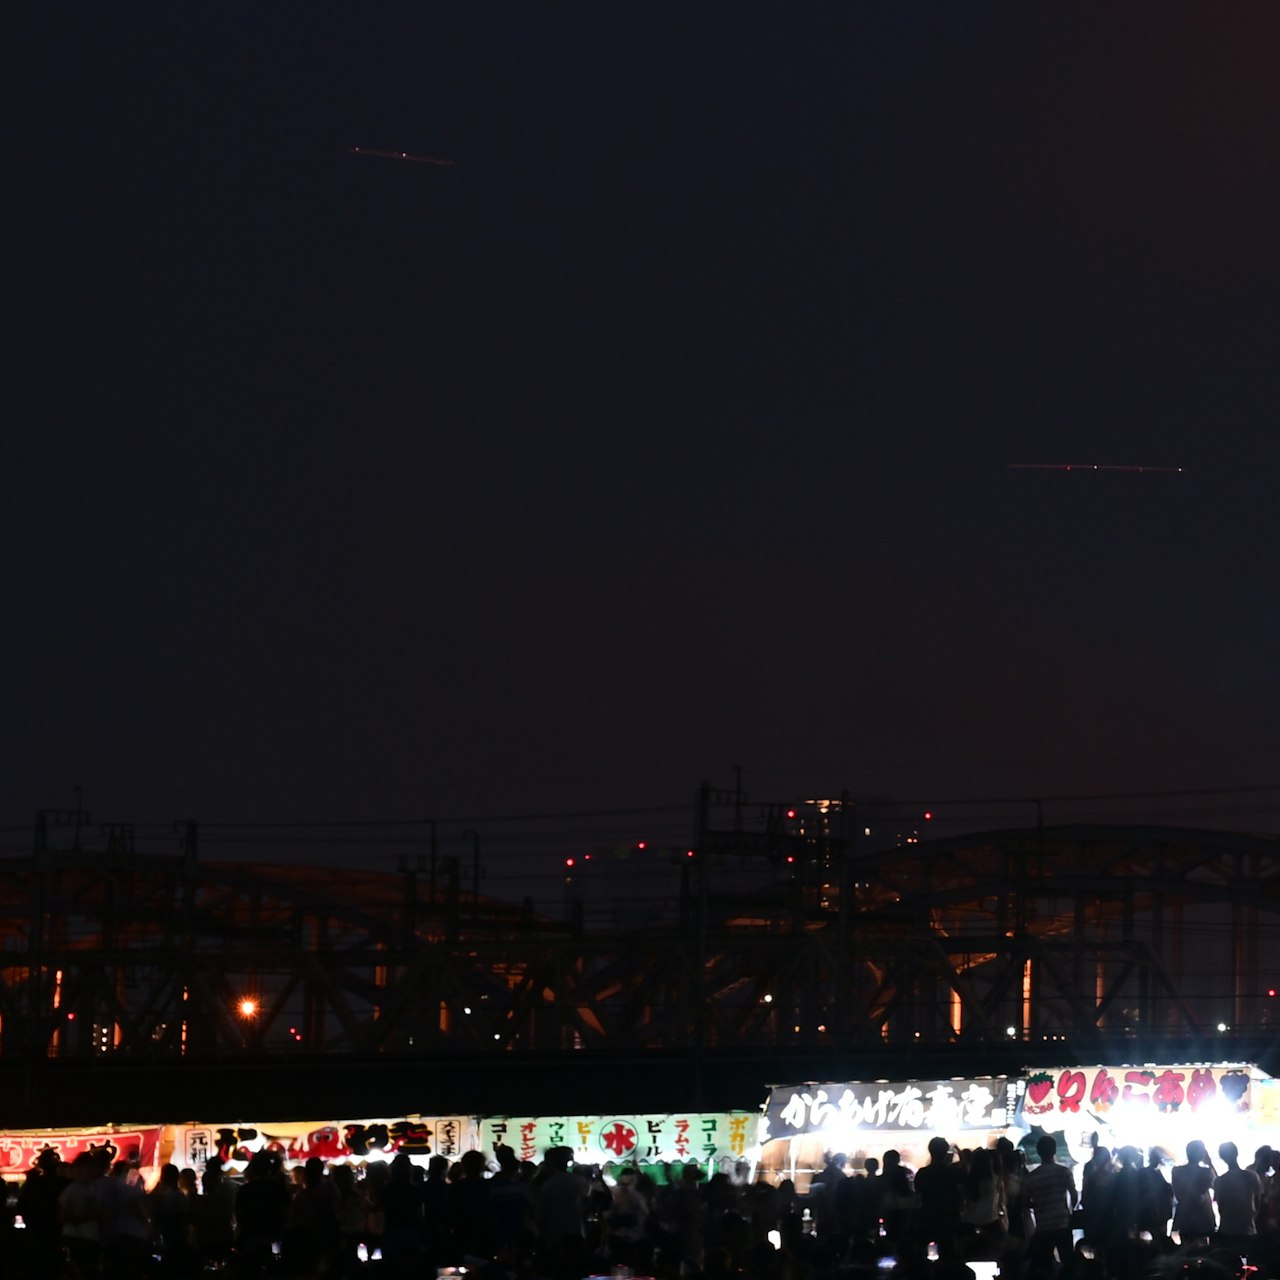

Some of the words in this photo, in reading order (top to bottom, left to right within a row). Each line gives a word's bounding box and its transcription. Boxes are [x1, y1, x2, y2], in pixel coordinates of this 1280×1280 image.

[1057, 1070, 1217, 1111] りんごあめ
[520, 1122, 537, 1162] オレンジ
[549, 1122, 564, 1147] ウーロ
[646, 1120, 666, 1157] ビール
[674, 1119, 690, 1157] ラムネ
[701, 1119, 718, 1158] コーラ
[729, 1117, 749, 1156] ポカリ
